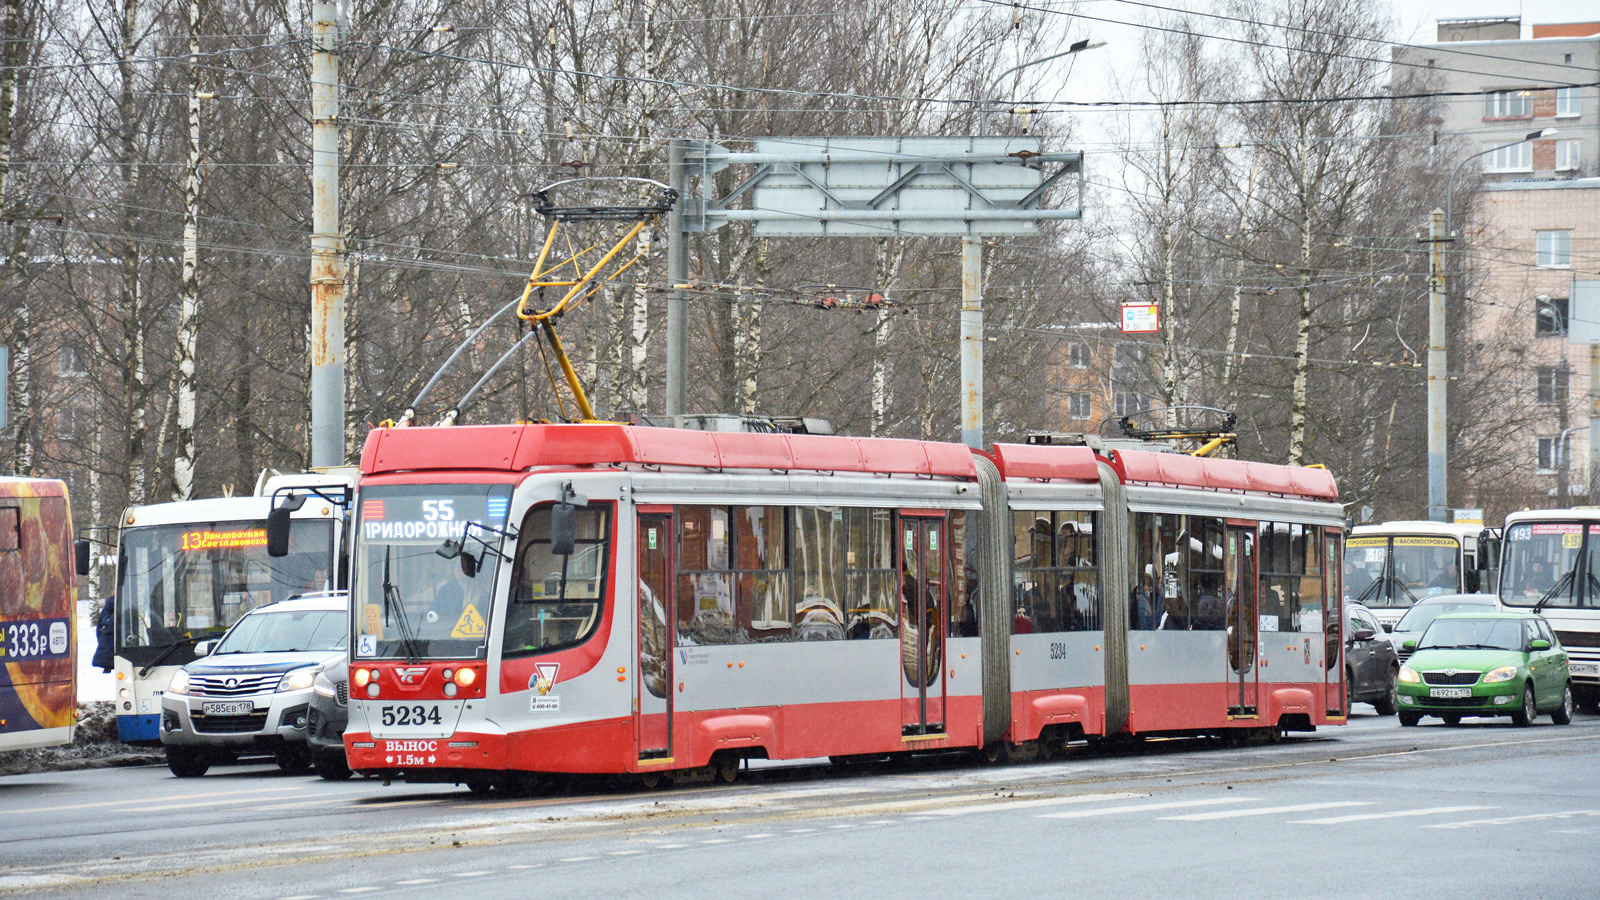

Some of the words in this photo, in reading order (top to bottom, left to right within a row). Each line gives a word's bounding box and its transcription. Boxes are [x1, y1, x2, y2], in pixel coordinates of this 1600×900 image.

[422, 500, 454, 521] 55
[182, 532, 201, 549] 13
[201, 538, 268, 548] Светлановски
[1050, 642, 1066, 659] 5234
[382, 705, 442, 726] 5234
[385, 741, 438, 751] ВЫНОС
